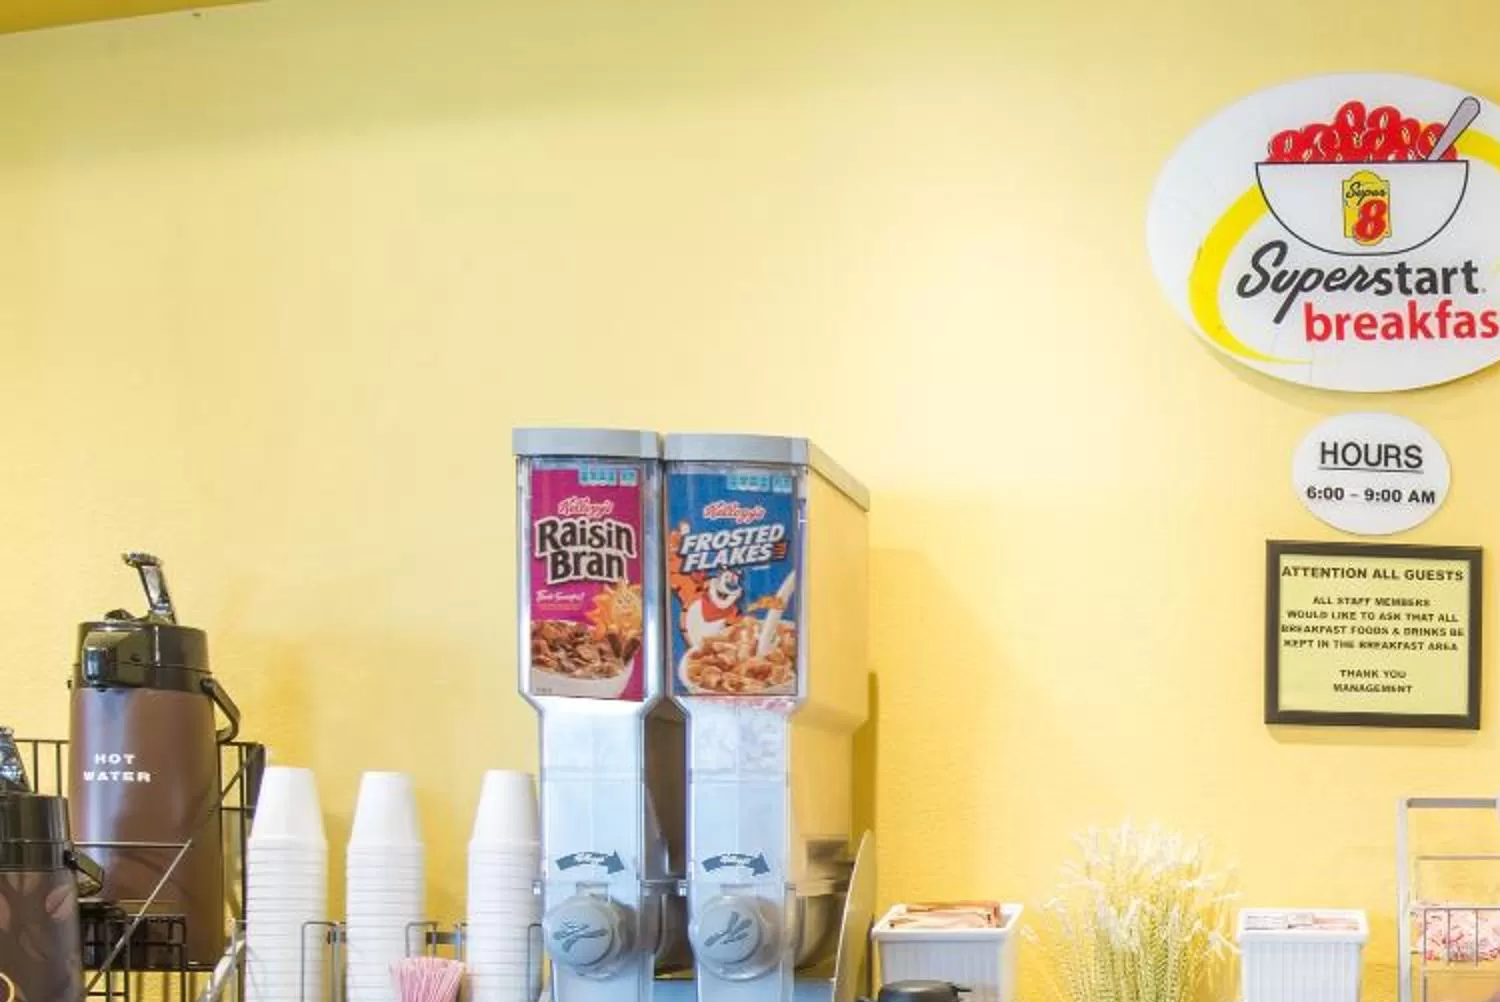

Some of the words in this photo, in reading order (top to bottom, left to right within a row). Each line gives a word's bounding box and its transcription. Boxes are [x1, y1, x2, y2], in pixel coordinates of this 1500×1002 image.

[1346, 183, 1387, 204] Super
[1354, 199, 1387, 241] 8
[1237, 240, 1479, 324] Superstart
[1321, 442, 1422, 469] HOURS
[1307, 487, 1345, 501] 6:00
[1364, 488, 1402, 503] 9:00
[1408, 490, 1435, 504] AM
[536, 518, 636, 556] Raisin
[681, 523, 786, 554] FROSTED
[684, 543, 774, 572] FLAKES
[550, 551, 625, 581] Bran
[1282, 566, 1366, 580] ATTENTION
[1372, 568, 1399, 580] ALL
[1404, 569, 1464, 581] GUESTS
[1313, 596, 1333, 604] ALL
[1336, 596, 1370, 606] STAFF
[1374, 597, 1431, 607] MEMBERS
[1287, 610, 1328, 619] WOULD
[1331, 611, 1357, 620] LIKE
[1361, 612, 1375, 620] TO
[1379, 612, 1401, 621] ASK
[1405, 612, 1434, 622] THAT
[1437, 613, 1459, 622] ALL
[1281, 625, 1346, 635] BREAKFAST
[1350, 626, 1389, 635] FOODS
[1403, 627, 1447, 636] DRINKS
[1449, 628, 1465, 637] BE
[1283, 639, 1314, 648] KEPT
[1317, 639, 1329, 648] IN
[1334, 640, 1355, 649] THE
[1359, 640, 1424, 650] BREAKFAST
[1427, 642, 1459, 651] AREA
[1339, 669, 1379, 679] THANK
[1382, 669, 1407, 679] YOU
[1332, 683, 1413, 694] MANAGEMENT
[94, 753, 136, 765] HOT
[83, 770, 151, 783] WATER
